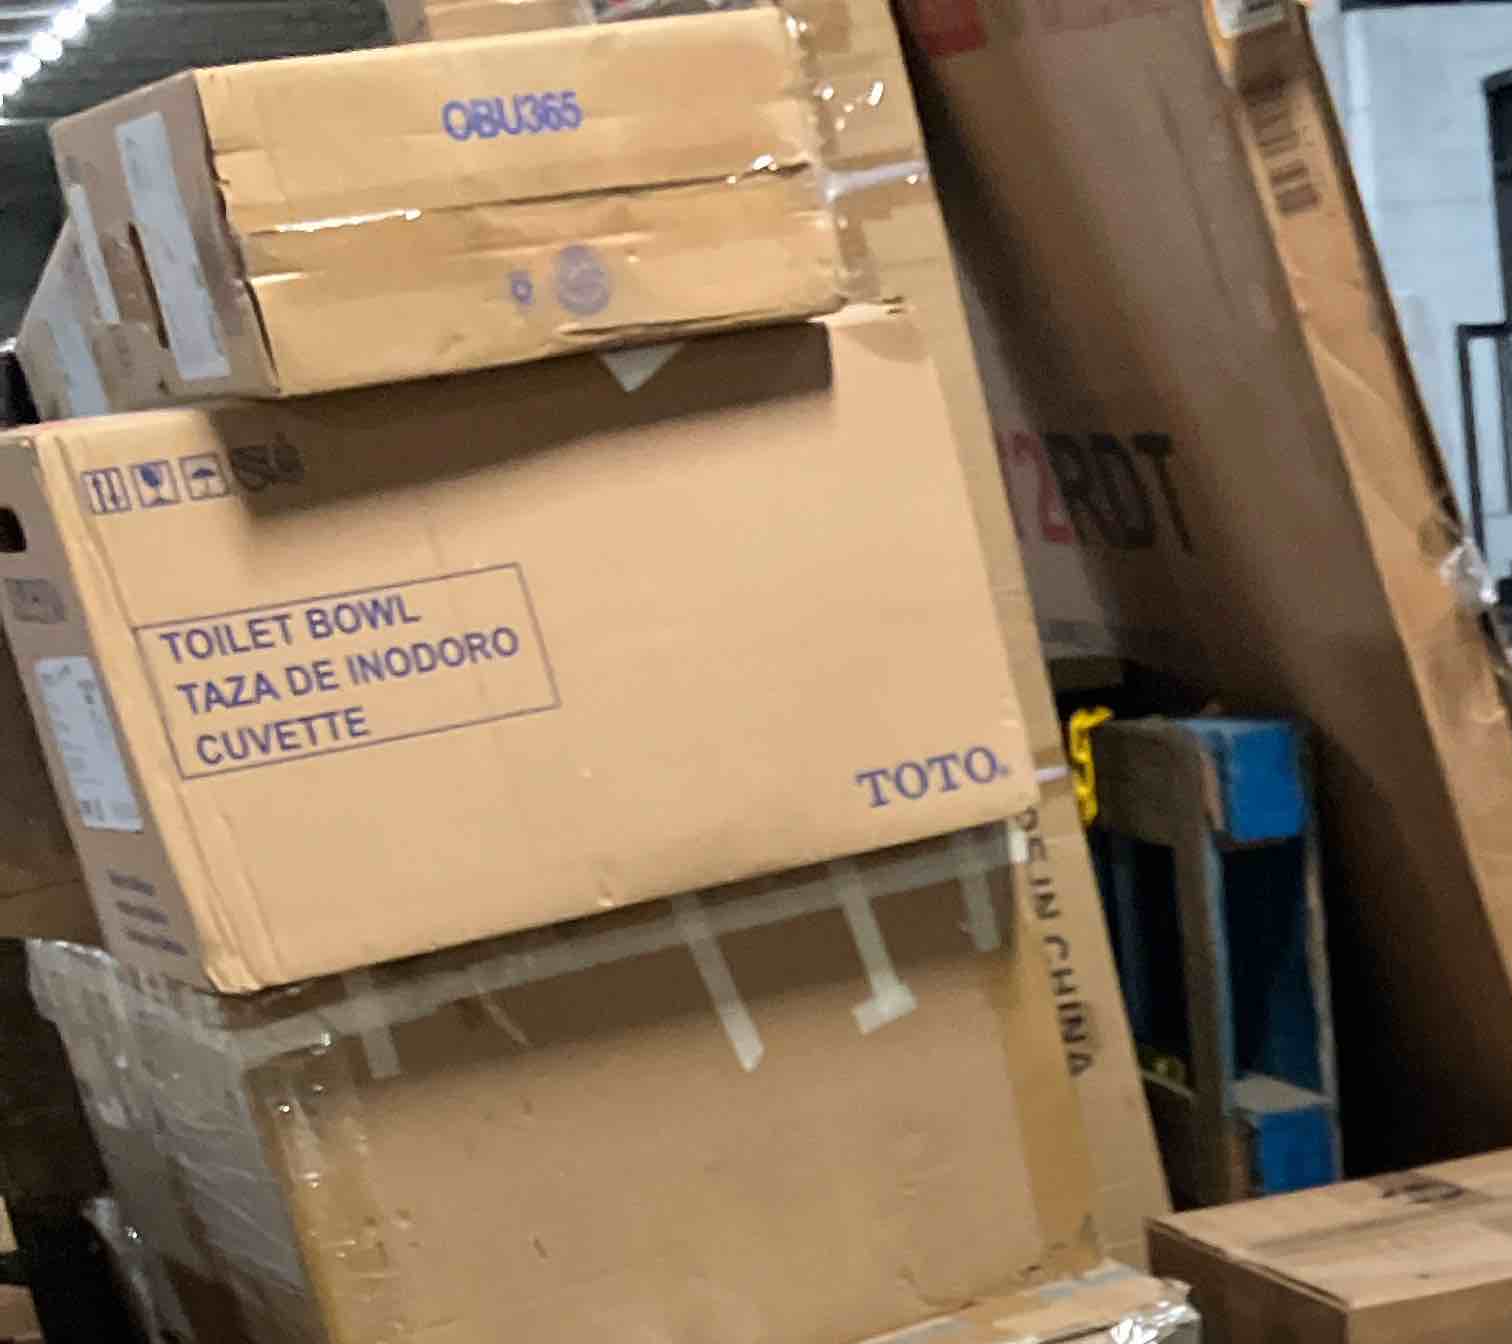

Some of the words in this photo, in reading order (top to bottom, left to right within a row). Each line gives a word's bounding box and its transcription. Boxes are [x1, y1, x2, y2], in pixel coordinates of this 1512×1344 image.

[442, 91, 583, 140] OBU365
[160, 613, 293, 664] TOILET
[305, 594, 421, 640] BOWL
[177, 672, 280, 716] TAZA
[285, 659, 340, 697] DE
[346, 627, 519, 686] INODORO
[196, 706, 371, 765] CUVETTE
[1043, 933, 1094, 1077] CHINA
